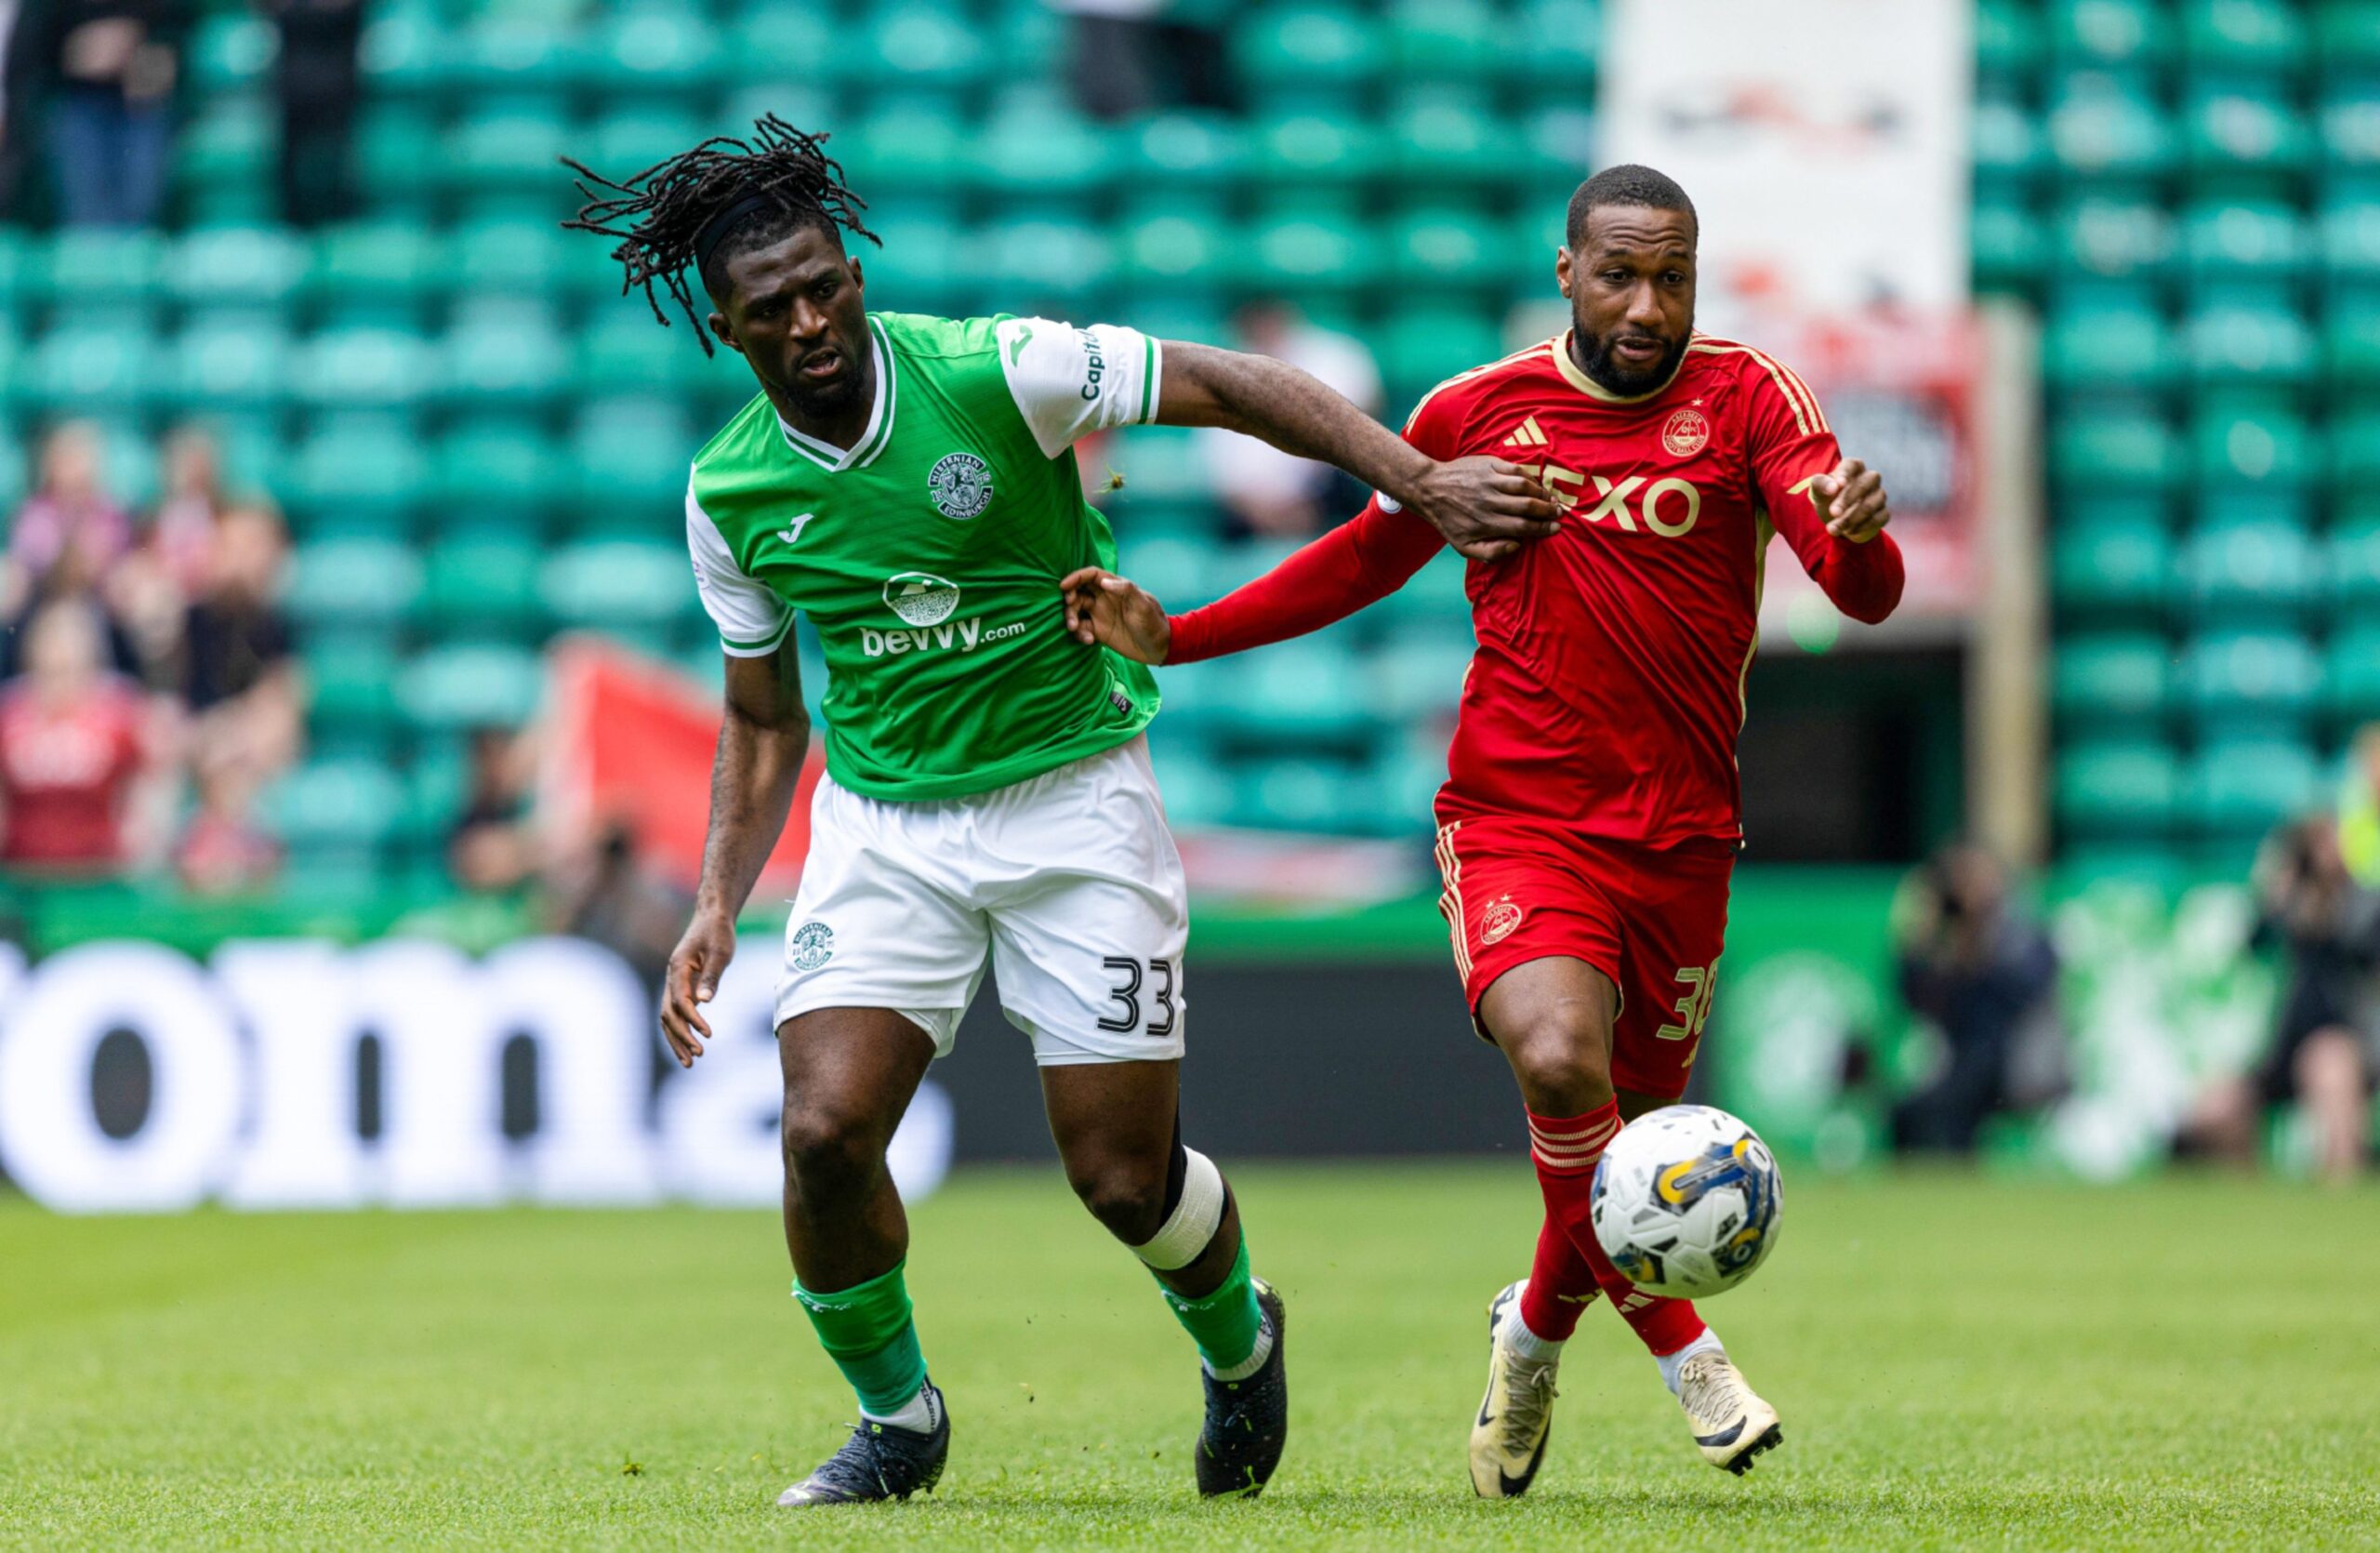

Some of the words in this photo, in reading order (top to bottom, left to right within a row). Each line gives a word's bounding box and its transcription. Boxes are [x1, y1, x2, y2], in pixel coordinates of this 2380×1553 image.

[932, 455, 981, 483] HIBERNIAN
[944, 491, 990, 518] EDINBURGH
[1519, 463, 1700, 538] EXO
[858, 617, 1026, 657] bevvy.com
[1096, 955, 1175, 1037] 33
